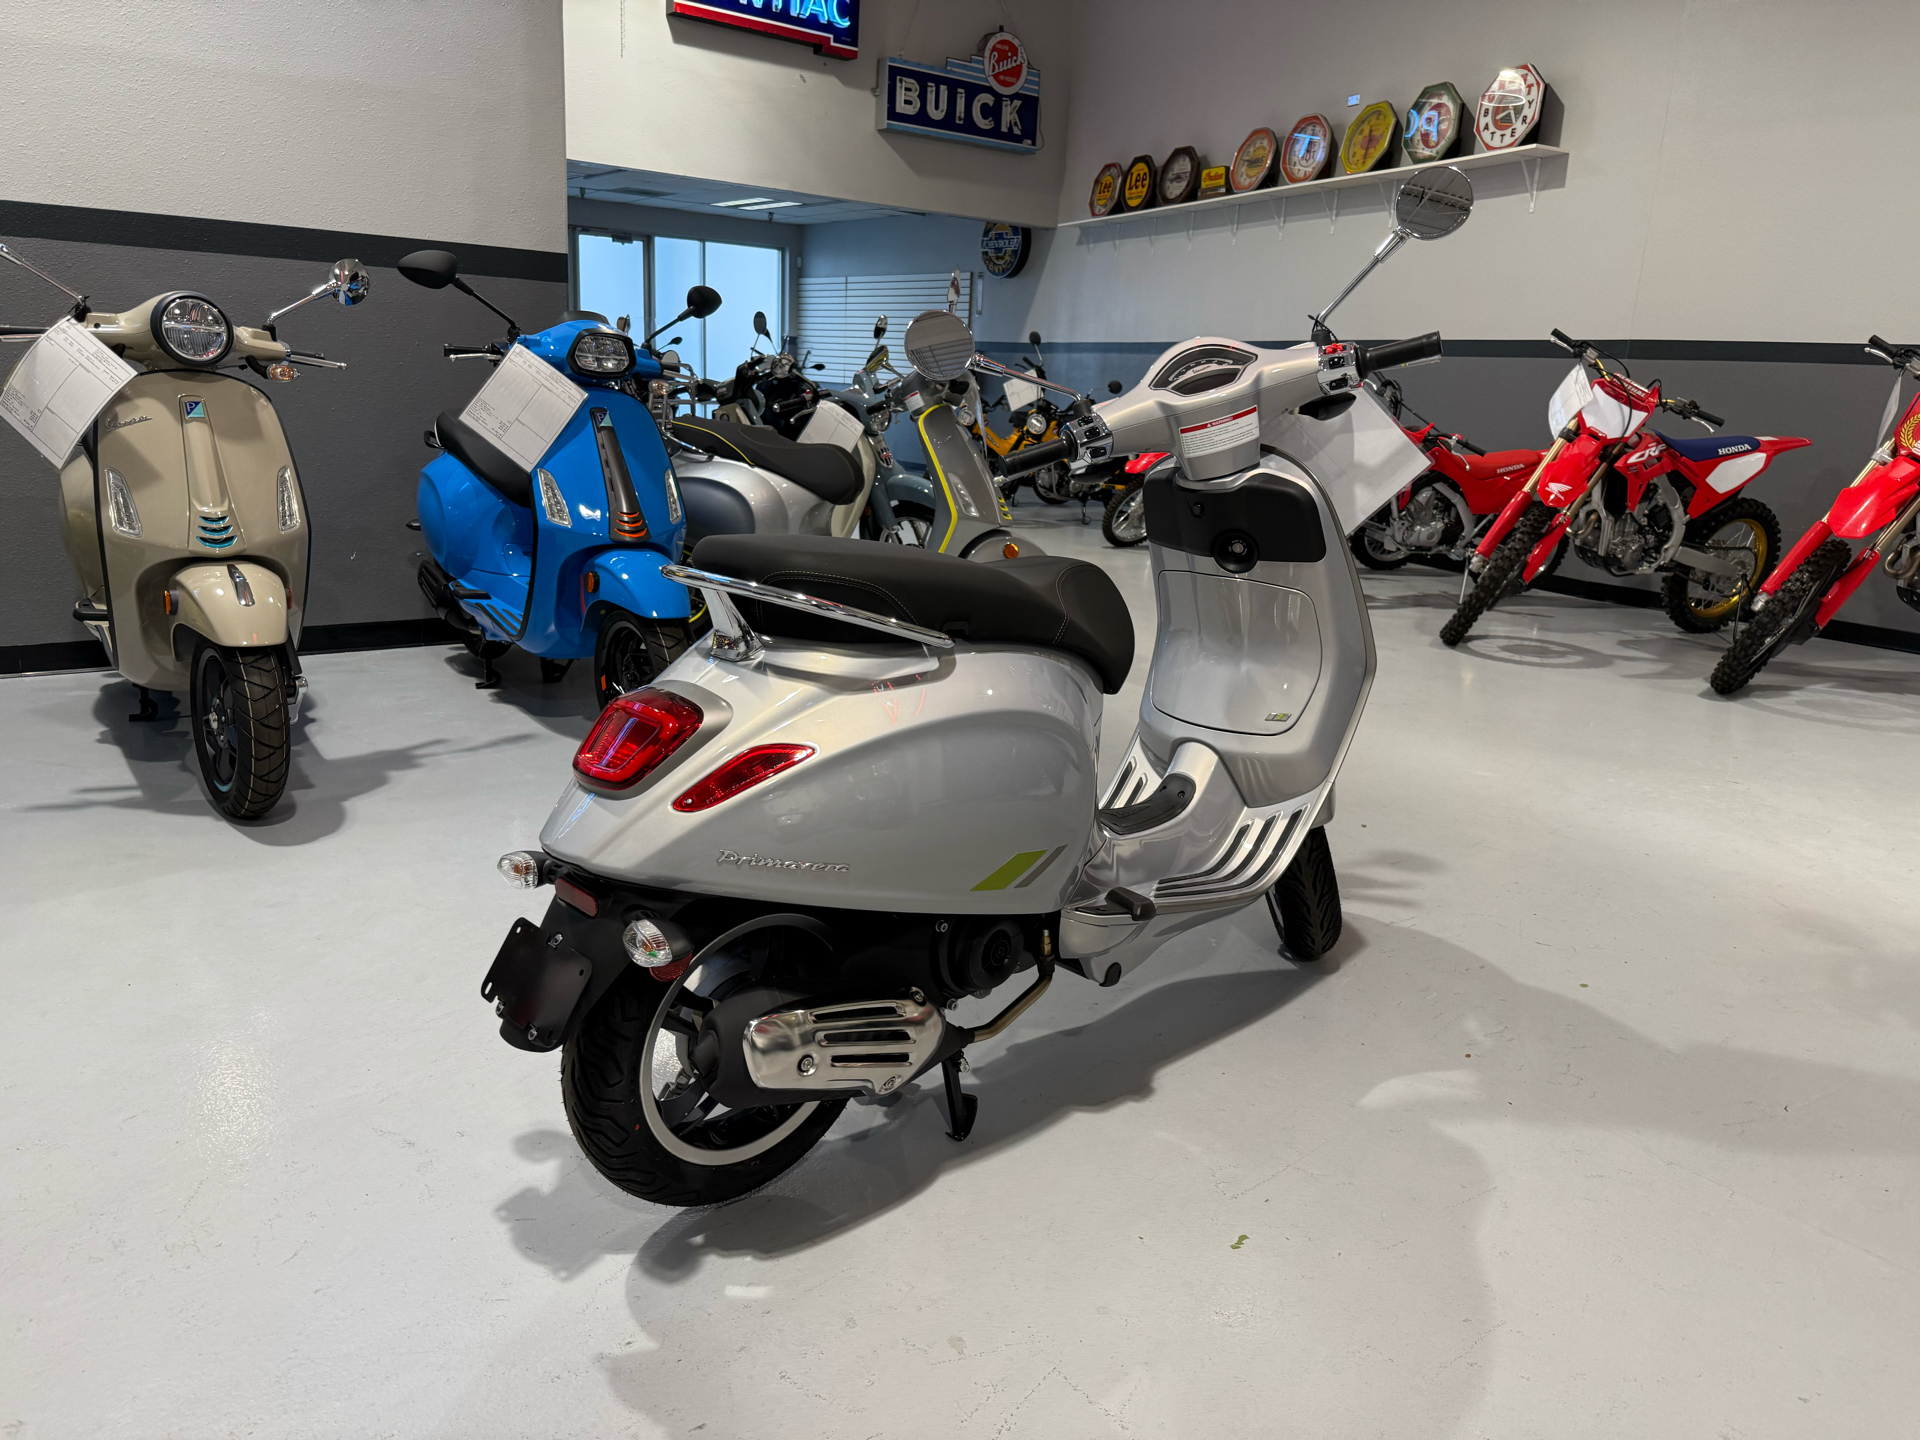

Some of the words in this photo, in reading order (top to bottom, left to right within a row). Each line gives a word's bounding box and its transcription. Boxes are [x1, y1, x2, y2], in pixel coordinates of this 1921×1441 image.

[988, 45, 1026, 77] Buick
[896, 74, 1022, 135] BUICK
[1483, 99, 1535, 143] BATTERY
[1098, 181, 1112, 195] Lee
[1128, 172, 1148, 191] Lee
[1626, 443, 1667, 464] CRF
[1717, 443, 1752, 456] HONDA
[1496, 463, 1526, 474] HONDA
[717, 848, 850, 873] Primavera
